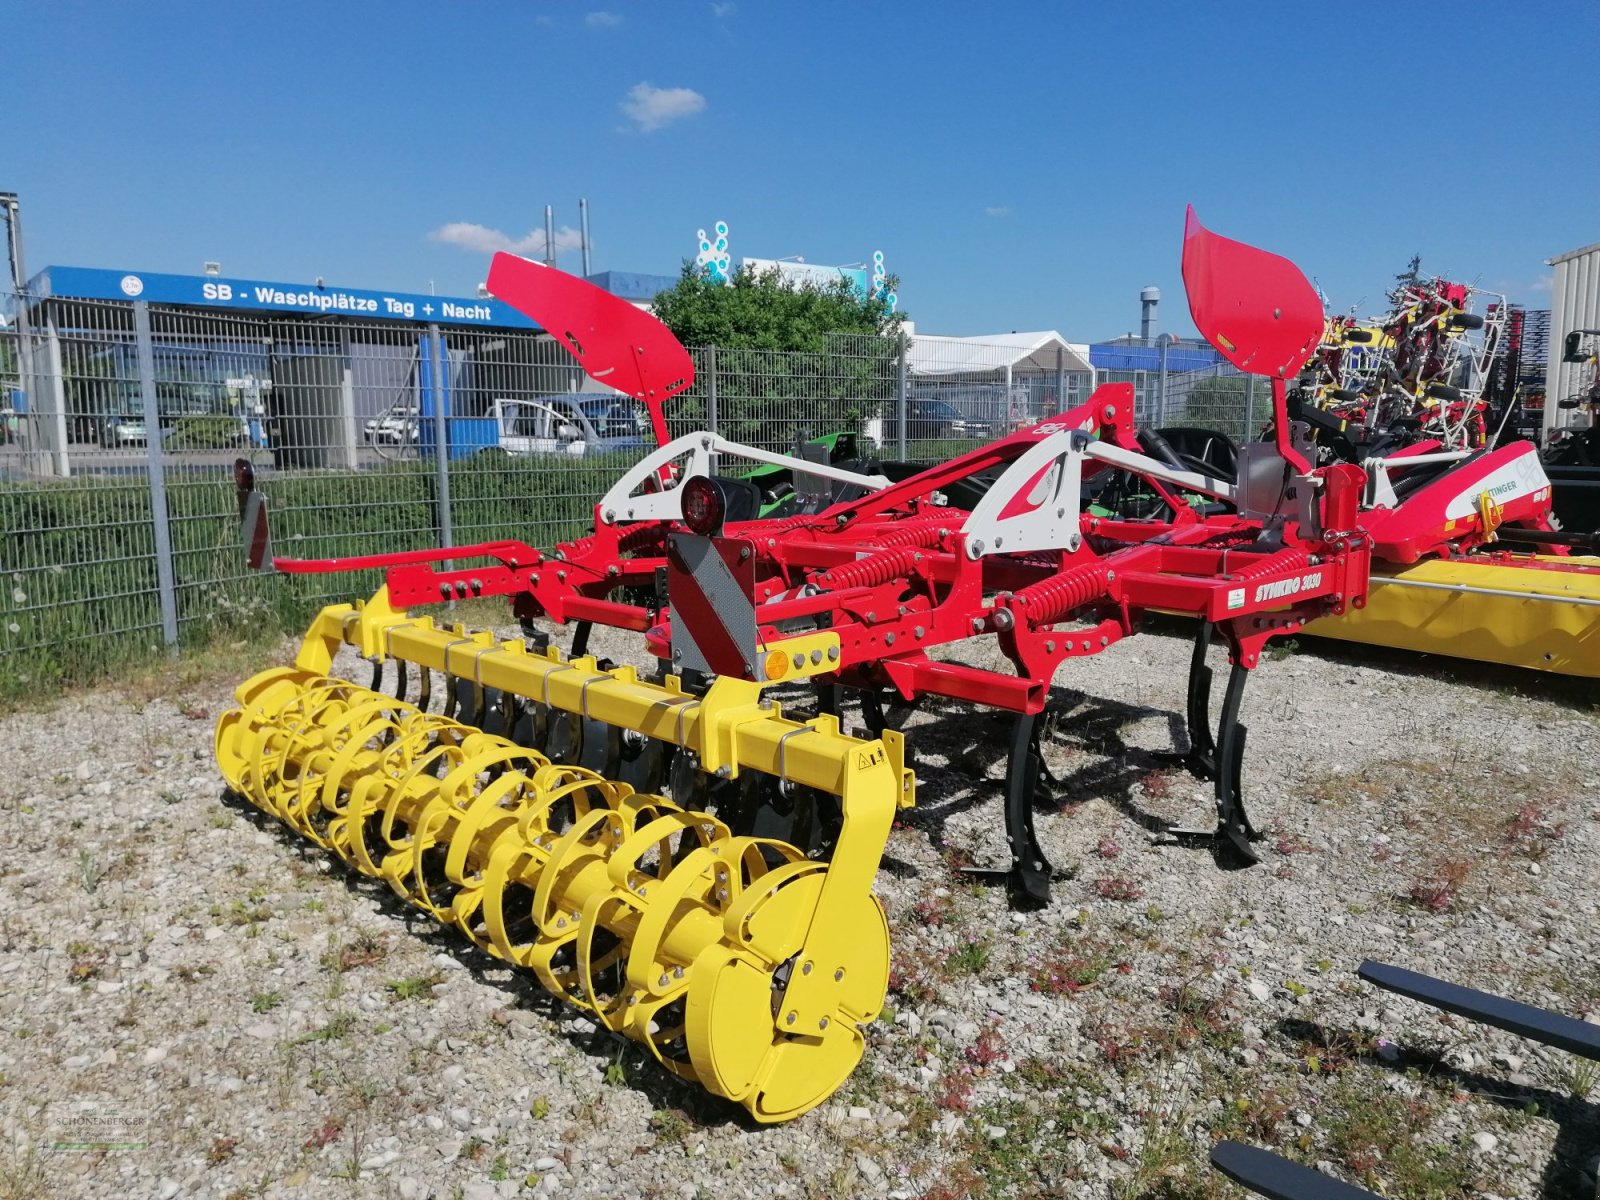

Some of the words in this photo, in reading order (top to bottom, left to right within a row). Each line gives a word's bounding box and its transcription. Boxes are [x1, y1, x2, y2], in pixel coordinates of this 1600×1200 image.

[203, 284, 232, 300] SB
[255, 287, 378, 311] Waschplätze
[384, 298, 415, 317] Tag
[422, 303, 434, 315] +
[442, 303, 491, 320] Nacht
[1255, 577, 1301, 602] SYNKRO
[1301, 572, 1322, 591] 3030
